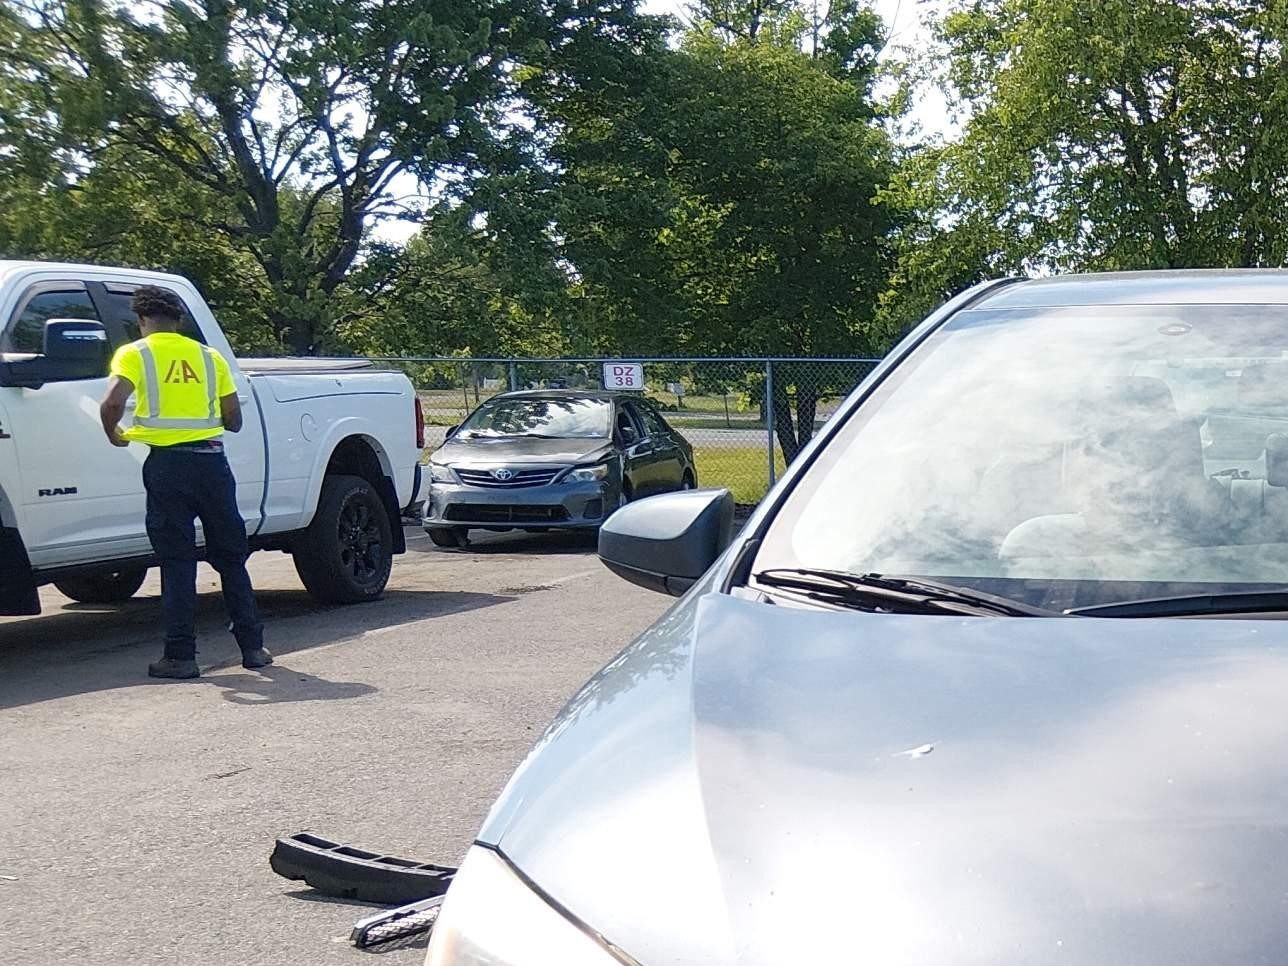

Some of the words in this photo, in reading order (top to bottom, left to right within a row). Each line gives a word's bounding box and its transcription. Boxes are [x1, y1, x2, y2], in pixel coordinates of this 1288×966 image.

[613, 366, 635, 377] DZ
[615, 376, 634, 387] 38
[38, 486, 78, 497] RAM
